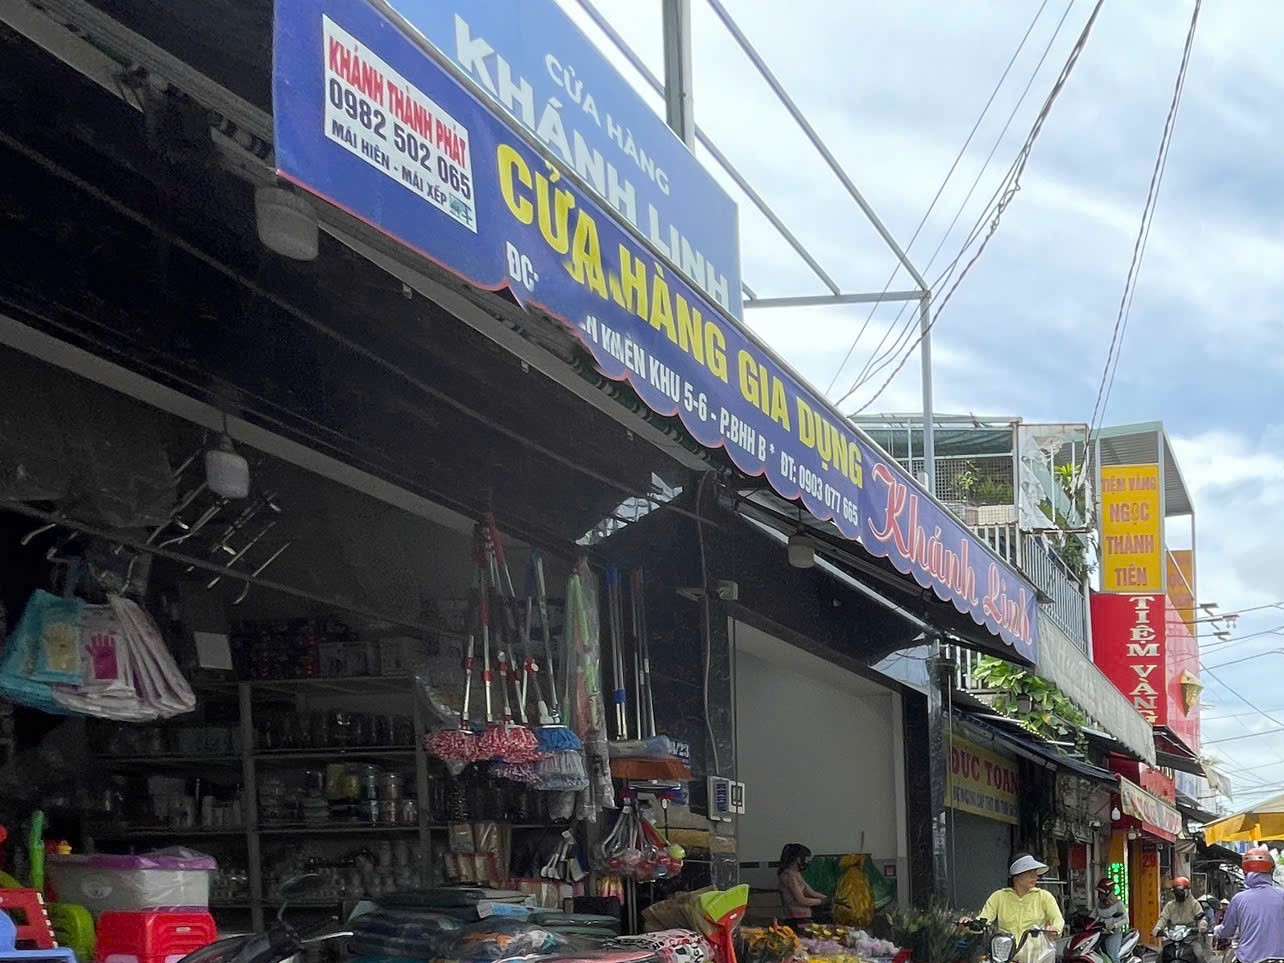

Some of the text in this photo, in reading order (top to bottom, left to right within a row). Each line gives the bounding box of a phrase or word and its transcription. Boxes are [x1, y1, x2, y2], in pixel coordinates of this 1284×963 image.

[329, 36, 466, 170] KHÁNH THÀNH PHÁT
[330, 78, 471, 200] 0982 502 065
[332, 119, 357, 148] MÁI
[361, 138, 390, 171] HIÊN
[402, 166, 424, 191] MÁI
[427, 182, 447, 206] XẾP
[455, 13, 730, 314] KHÁNH LINH
[545, 54, 670, 195] CỬA HÀNG
[618, 243, 728, 384] HÀNG
[738, 349, 790, 433] GIA
[796, 395, 863, 489] DỤNG
[648, 355, 681, 403] KHU
[684, 381, 707, 422] 5-6
[720, 406, 756, 456] P.BHH
[758, 434, 767, 462] B
[781, 450, 796, 484] ĐT:
[799, 464, 823, 502] 0903
[824, 484, 841, 514] 077
[843, 496, 858, 527] 665
[868, 463, 1032, 646] Khánh Linh
[1126, 596, 1160, 657] TIỆM
